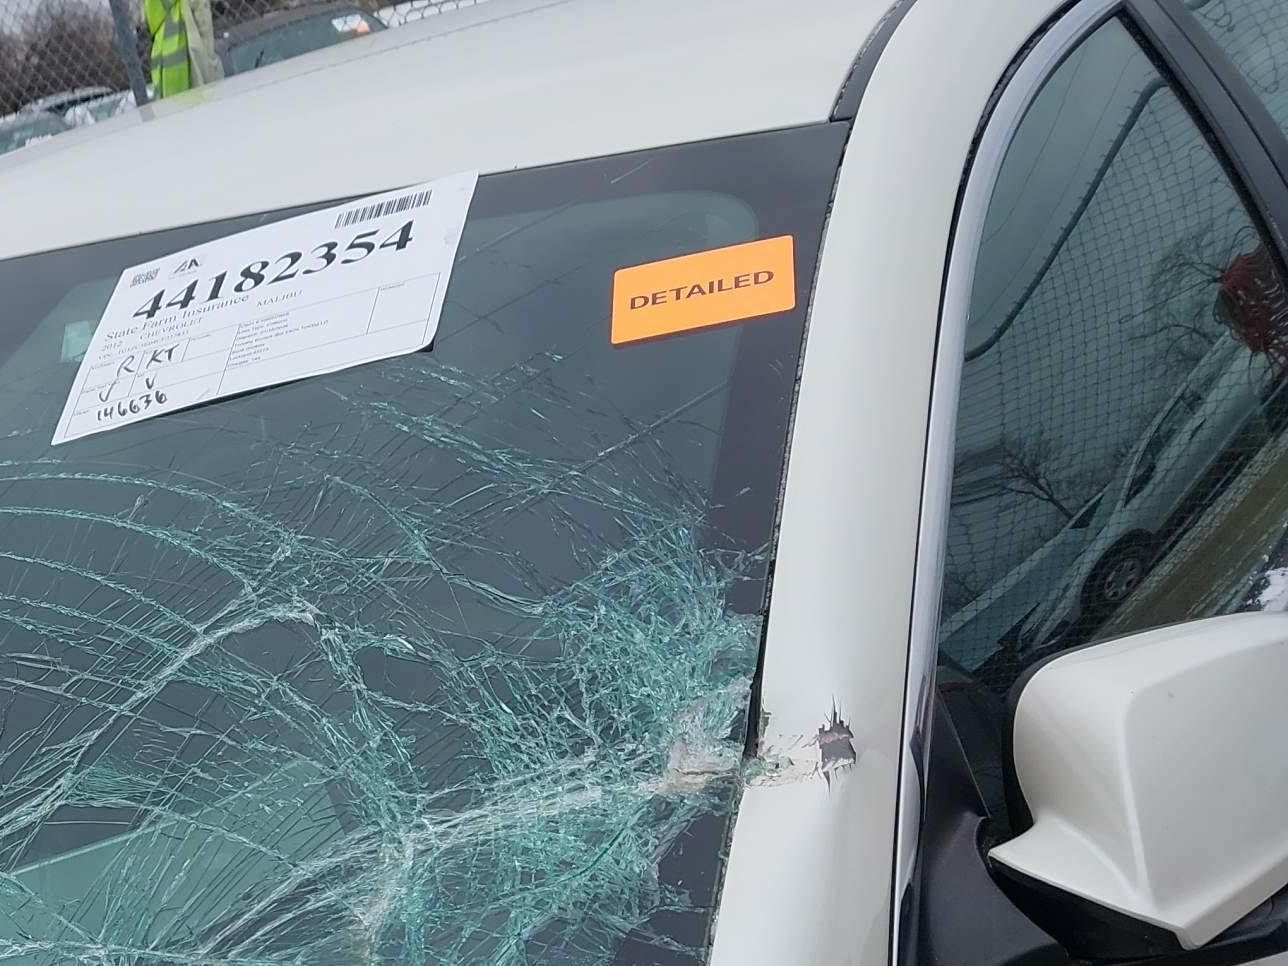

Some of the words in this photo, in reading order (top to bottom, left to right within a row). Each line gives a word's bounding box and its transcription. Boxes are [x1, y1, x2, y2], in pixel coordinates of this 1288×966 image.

[132, 218, 415, 320] 44182354
[629, 270, 775, 311] DETAILED
[105, 326, 139, 343] State
[142, 316, 177, 331] Farm
[182, 295, 250, 319] Insurance
[140, 317, 203, 341] CHEVROLET
[256, 290, 304, 308] MALIBU
